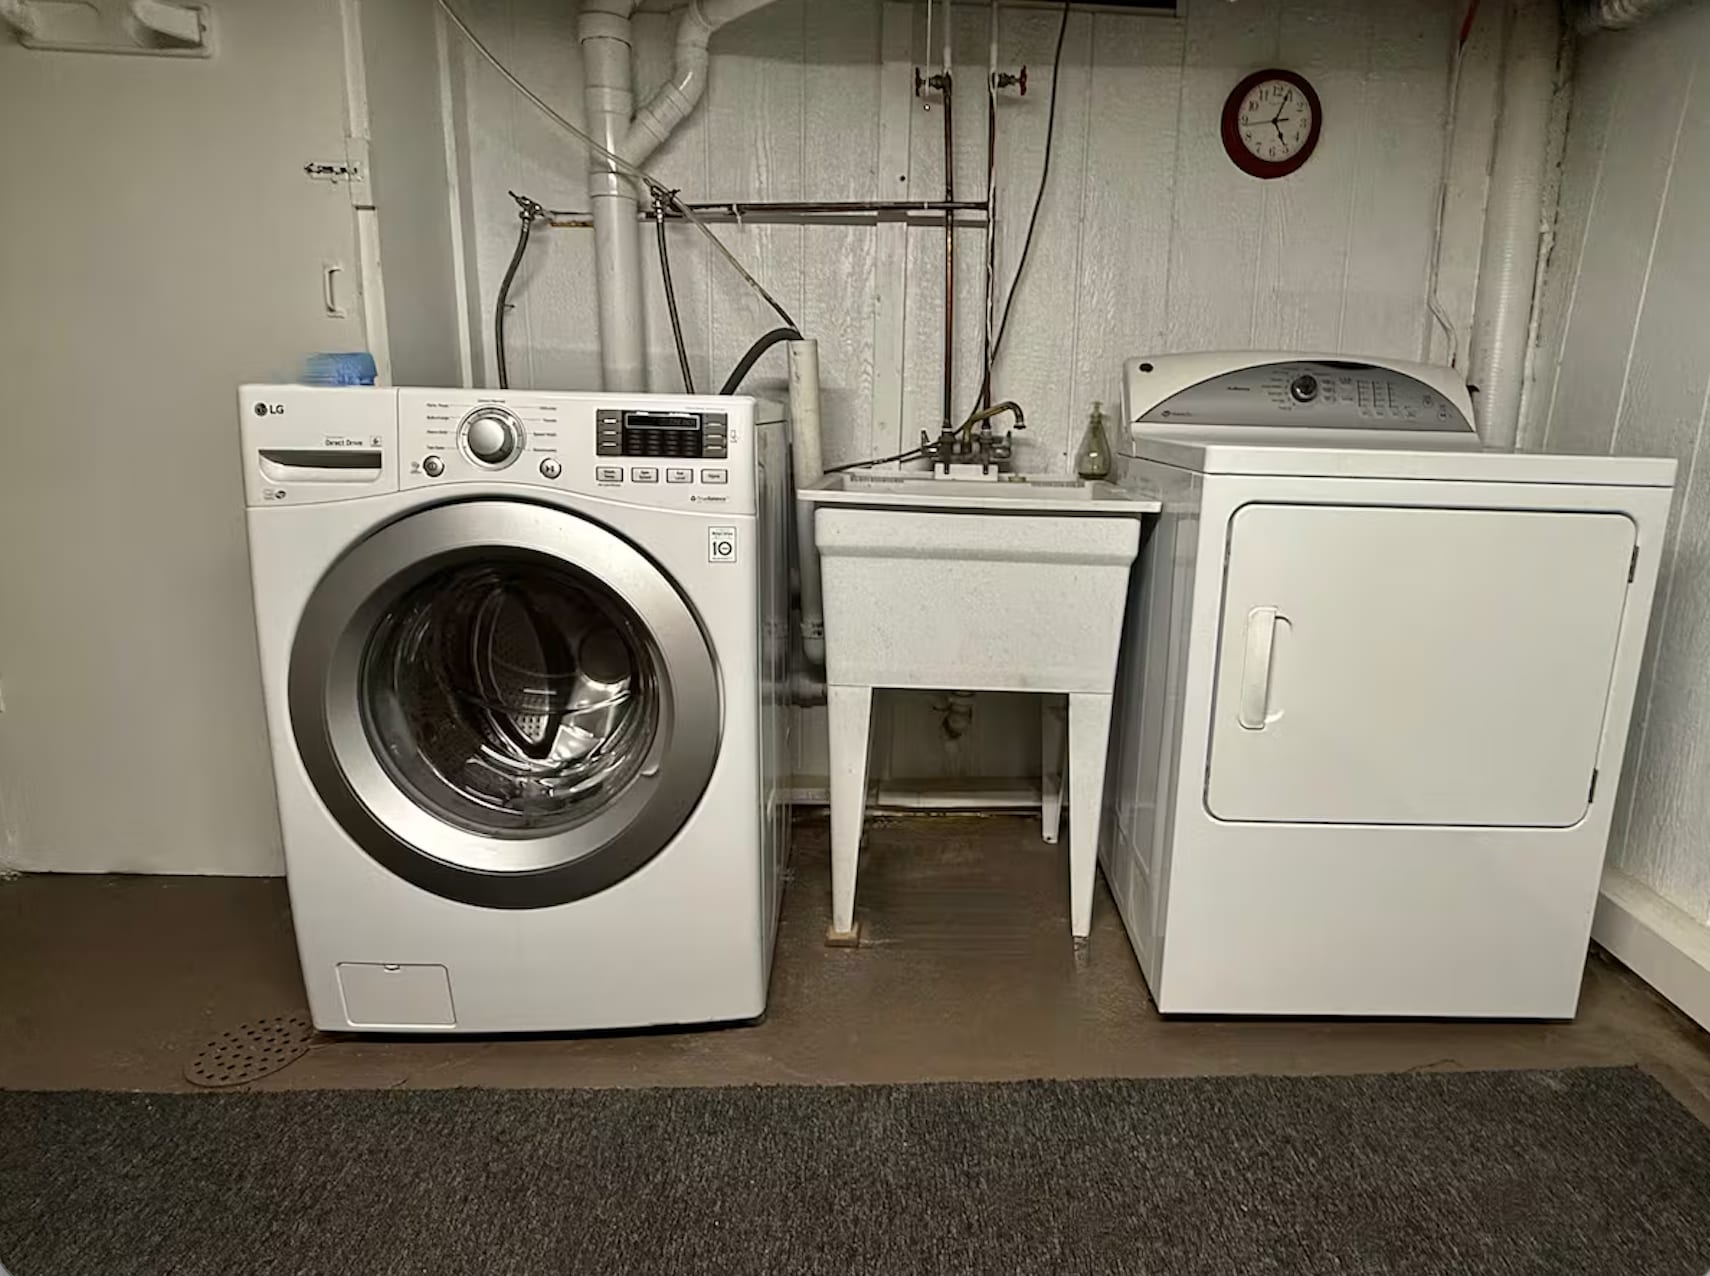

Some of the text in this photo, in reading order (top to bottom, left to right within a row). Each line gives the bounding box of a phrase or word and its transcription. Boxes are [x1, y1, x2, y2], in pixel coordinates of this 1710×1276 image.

[1259, 88, 1269, 101] 11
[1273, 85, 1284, 97] 12
[1248, 100, 1259, 112] 10
[1241, 114, 1249, 126] 9
[269, 404, 285, 415] LG
[325, 439, 363, 447] Direct Drive
